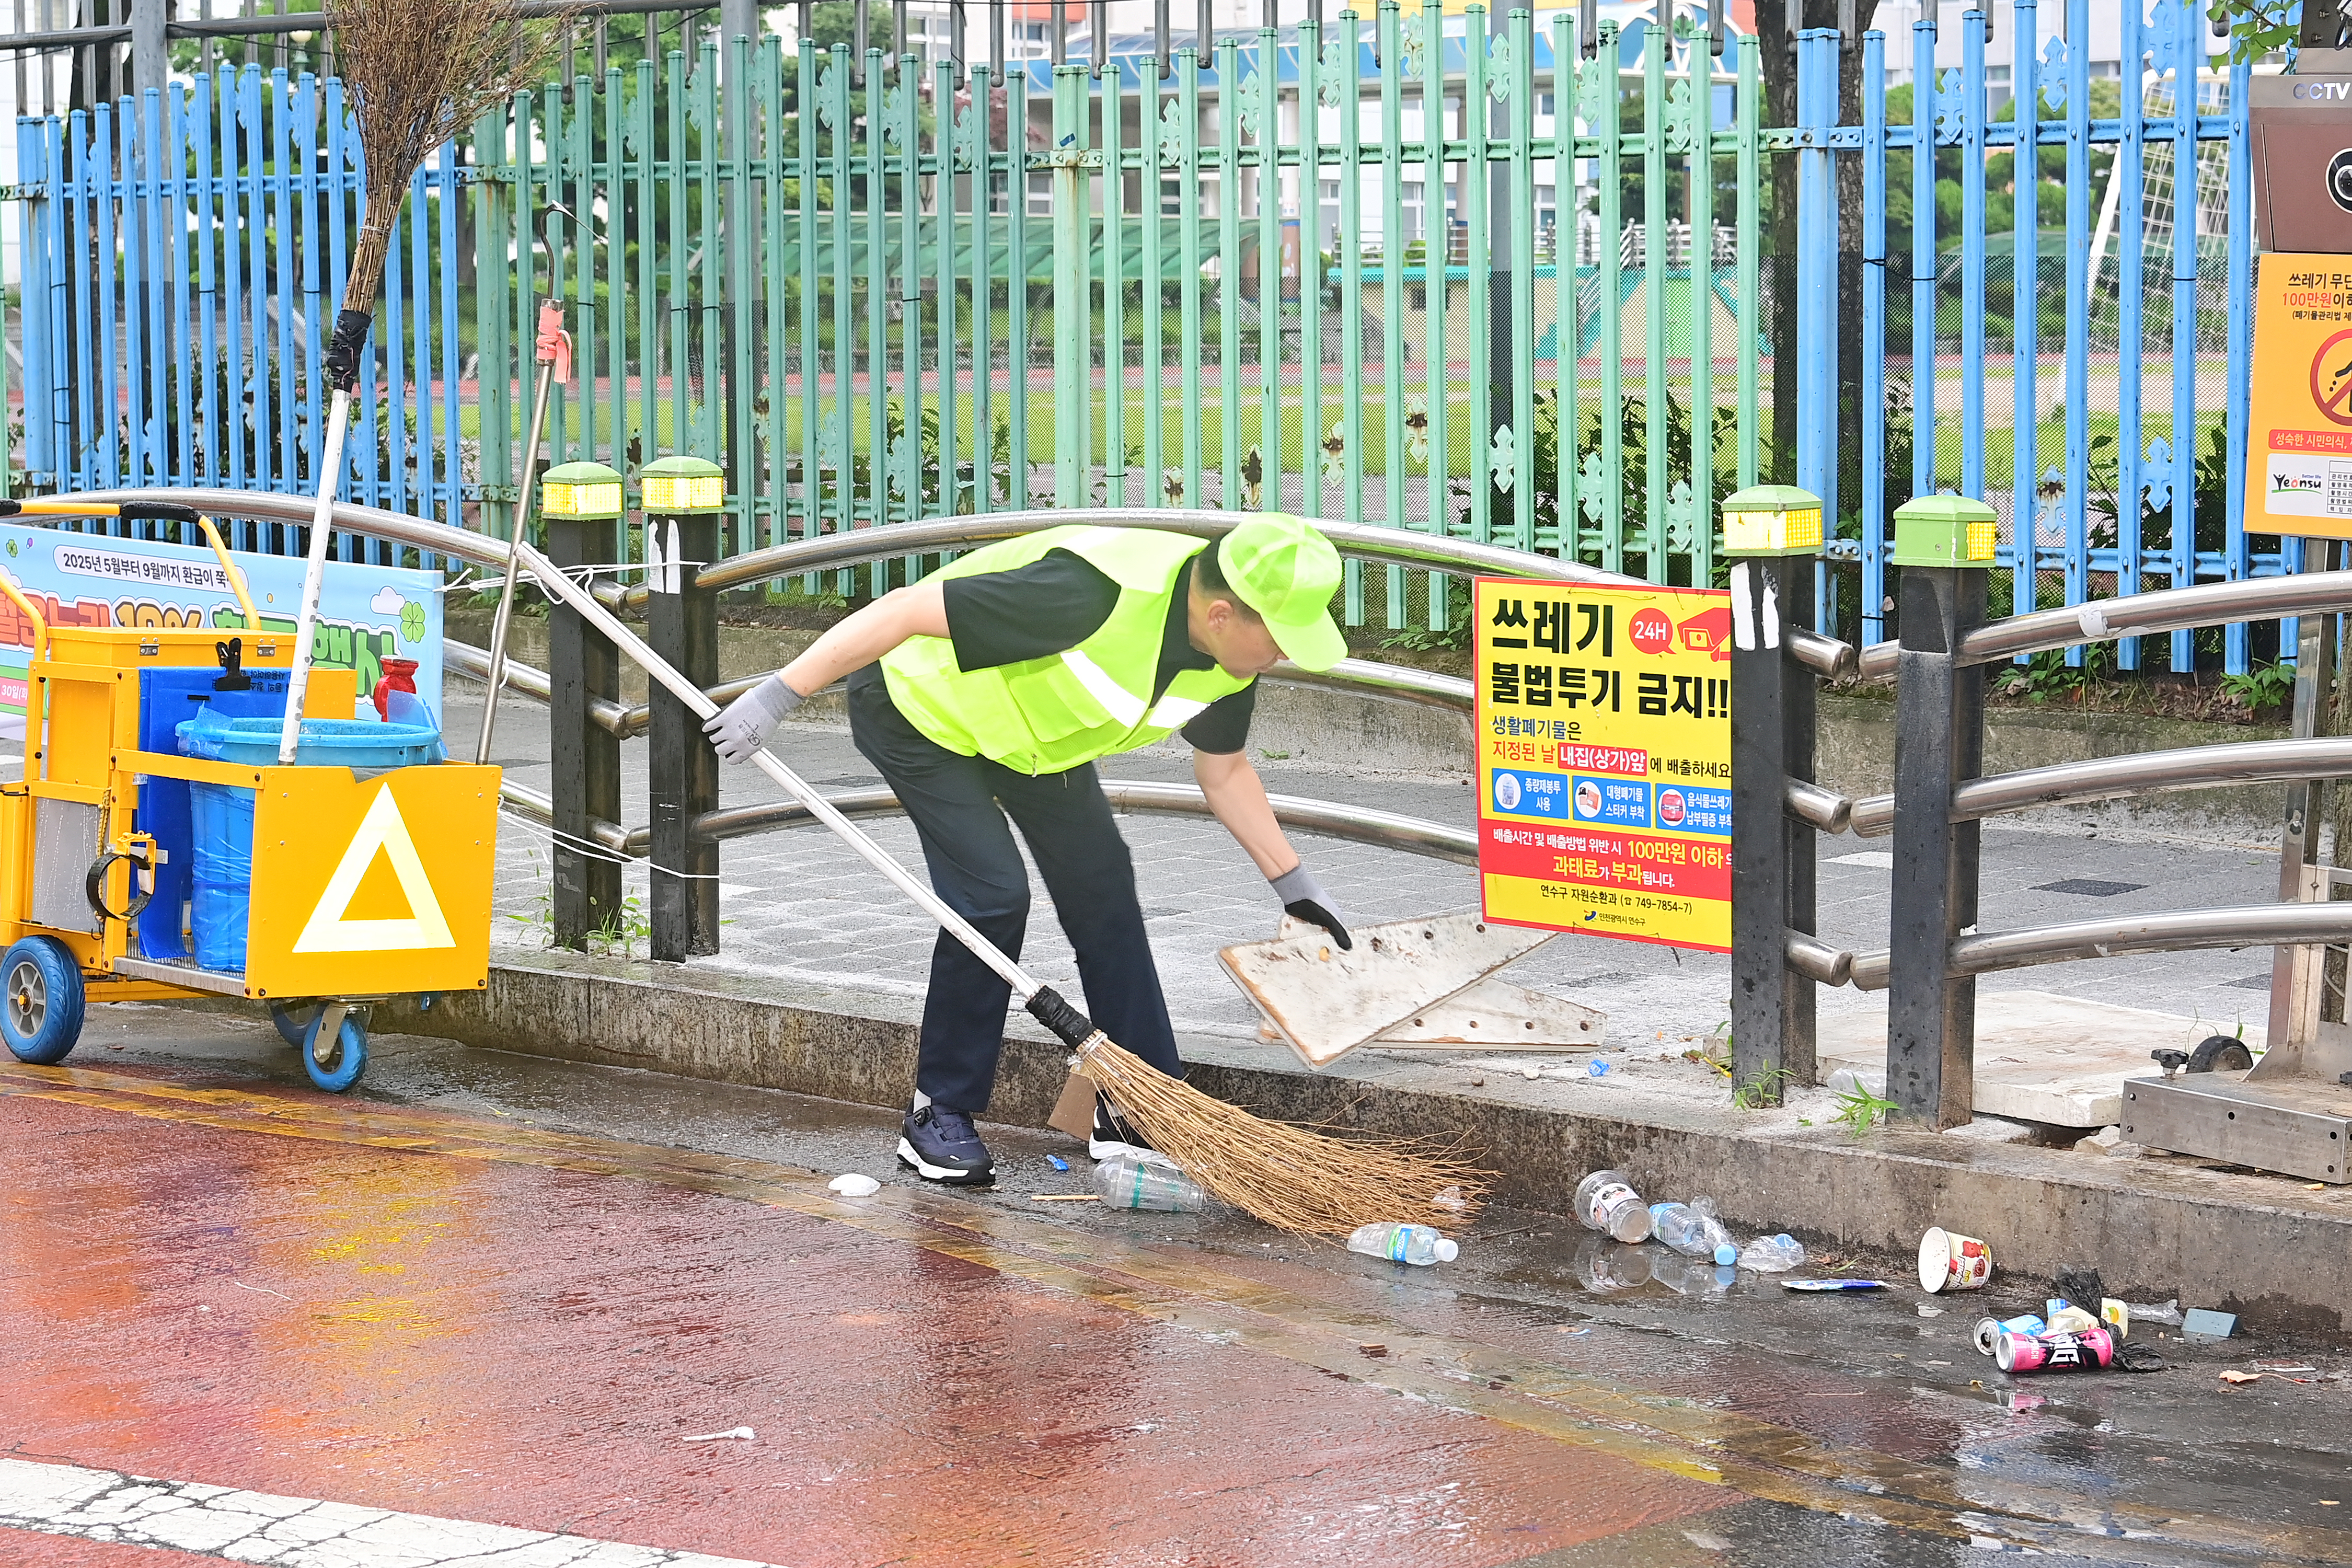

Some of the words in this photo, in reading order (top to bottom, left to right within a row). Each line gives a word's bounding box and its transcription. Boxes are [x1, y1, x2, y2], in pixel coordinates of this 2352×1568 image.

[2292, 82, 2351, 101] CCTV
[2288, 272, 2327, 290] 쓰레기
[2343, 312, 2352, 322] 제
[2275, 432, 2304, 447] 성숙한
[2306, 434, 2347, 449] 시민의식,
[2273, 473, 2322, 491] Yeonsu
[63, 553, 102, 572] 2025년
[104, 557, 141, 578] 5월부터
[143, 562, 181, 583] 9월까지
[182, 566, 214, 587] 환급이
[1492, 598, 1613, 657] 쓰레기
[1634, 620, 1667, 641] 24H
[1492, 662, 1621, 712] 불법투기
[1638, 672, 1728, 719] 금지!!
[1492, 714, 1582, 741] 생활폐기물은
[1492, 741, 1535, 762] 지정된
[1541, 744, 1555, 764] 날
[1560, 746, 1645, 774] 내집(상가)앞
[1650, 757, 1662, 774] 에
[1667, 759, 1731, 778] 배출하세요
[1525, 777, 1561, 795] 종량제봉투
[1606, 785, 1644, 803] 대형폐기물
[1536, 796, 1551, 812] 사용
[1687, 792, 1732, 811] 음식물쓰레기
[1605, 803, 1628, 818] 스티커
[1629, 804, 1645, 821] 부착
[1686, 810, 1716, 828] 납부필증
[1493, 828, 1533, 846] 배출시간
[1534, 833, 1545, 847] 및
[1547, 834, 1587, 852] 배출방법
[1588, 838, 1610, 854] 위반
[1610, 840, 1622, 856] 시
[1627, 840, 1686, 866] 100만원
[1691, 846, 1724, 869] 이하
[1553, 855, 1610, 881] 과태료가
[1611, 861, 1676, 888] 부과됩니다.
[1540, 884, 1568, 900] 연수구
[1571, 888, 1618, 906] 자원순환과
[1635, 896, 1693, 916] 749-7854~7)
[1599, 912, 1628, 925] 인천광역시
[1628, 915, 1646, 927] 연수구
